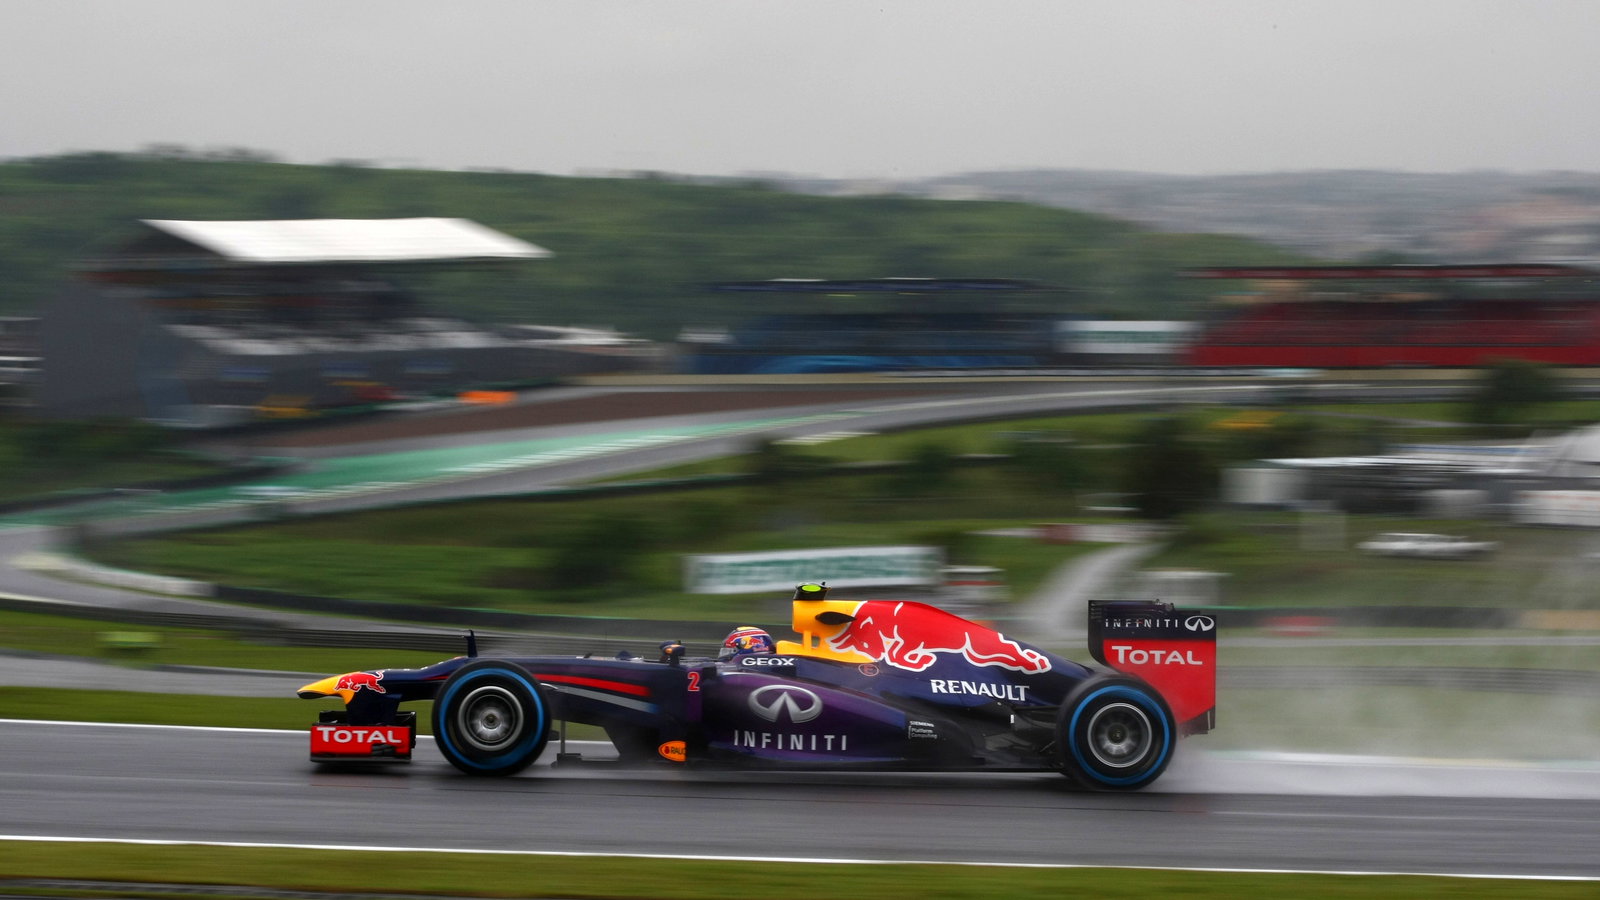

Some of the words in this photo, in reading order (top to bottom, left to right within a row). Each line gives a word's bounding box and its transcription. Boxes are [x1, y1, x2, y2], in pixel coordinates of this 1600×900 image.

[1104, 618, 1178, 628] INFINITI
[742, 656, 795, 666] GEOX
[1111, 645, 1203, 665] TOTAL
[687, 671, 700, 692] 2
[930, 679, 1030, 701] RENAULT
[316, 727, 402, 743] TOTAL
[733, 729, 848, 751] INFINITI
